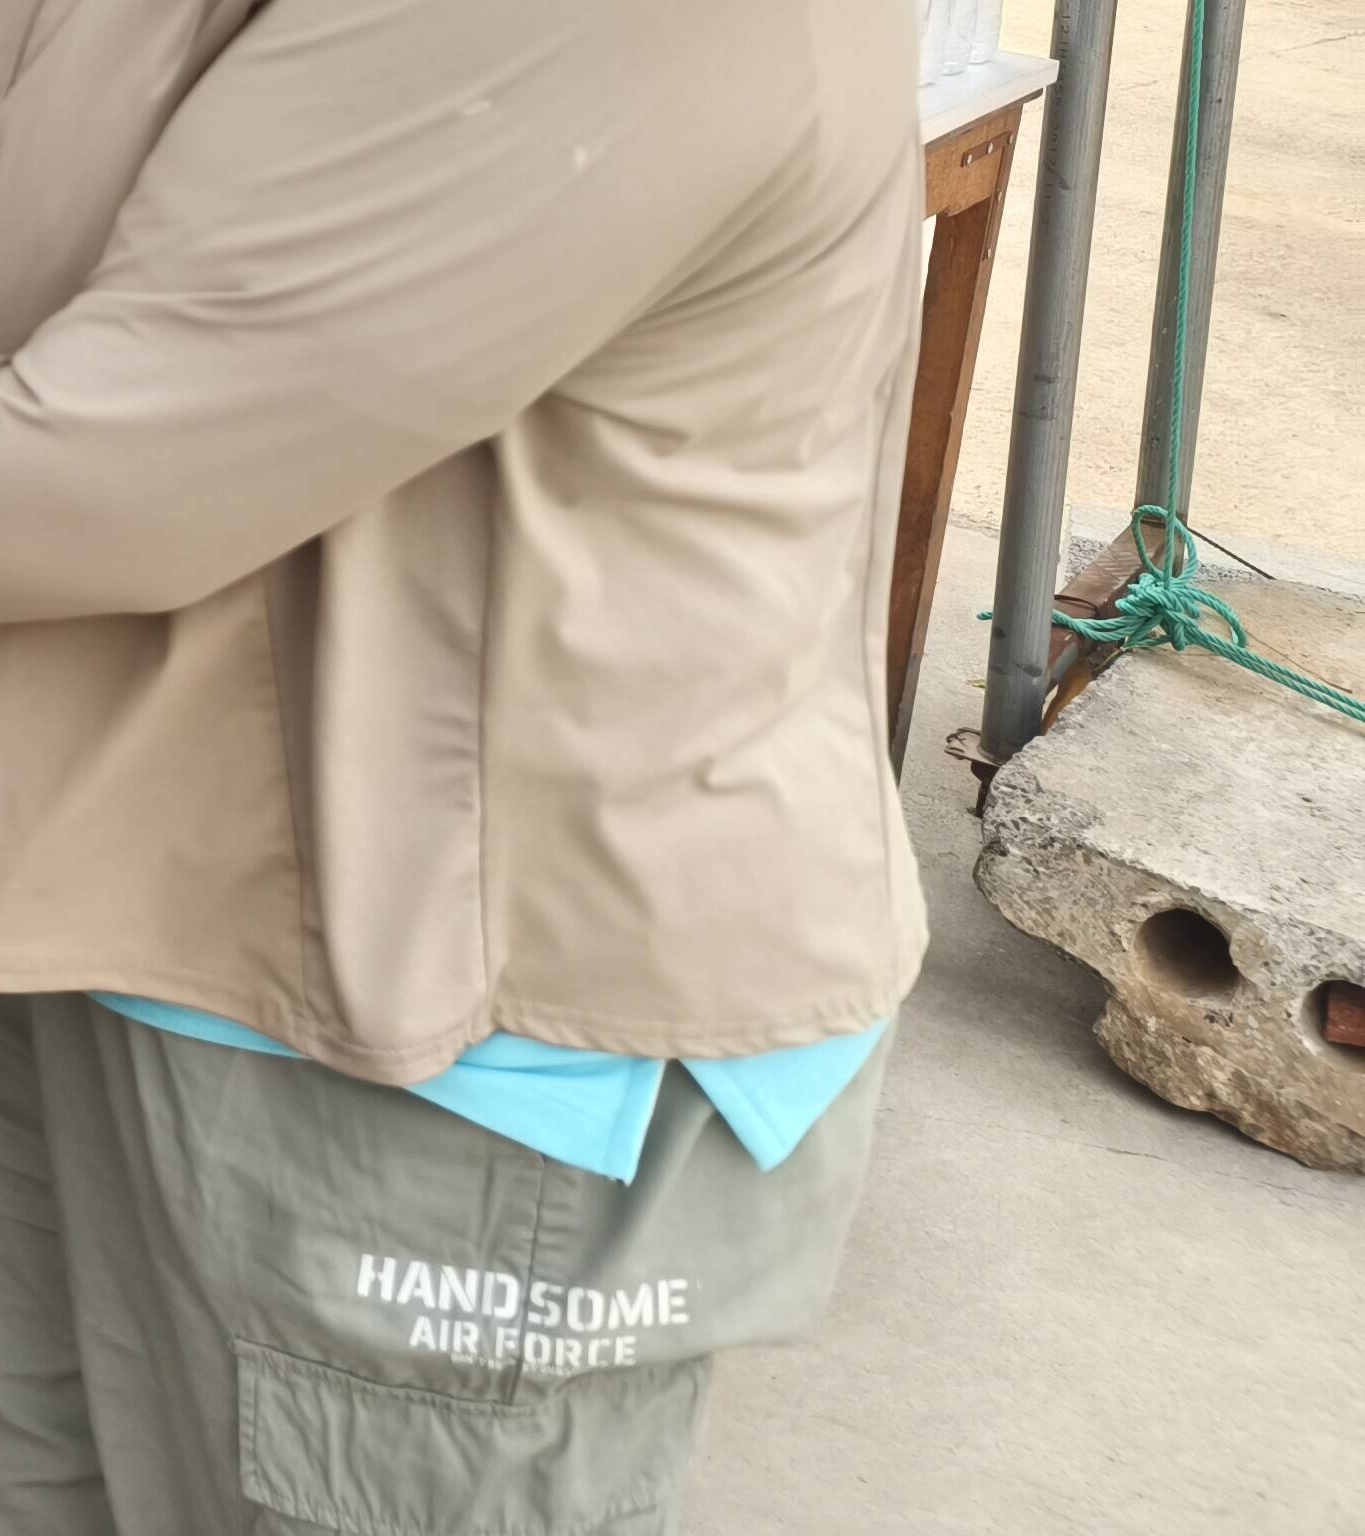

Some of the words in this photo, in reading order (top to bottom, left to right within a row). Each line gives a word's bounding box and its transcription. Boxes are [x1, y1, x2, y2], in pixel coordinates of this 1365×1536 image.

[357, 1253, 690, 1332] HANDSOME
[410, 1316, 480, 1354] AIR
[495, 1324, 637, 1367] FORCE
